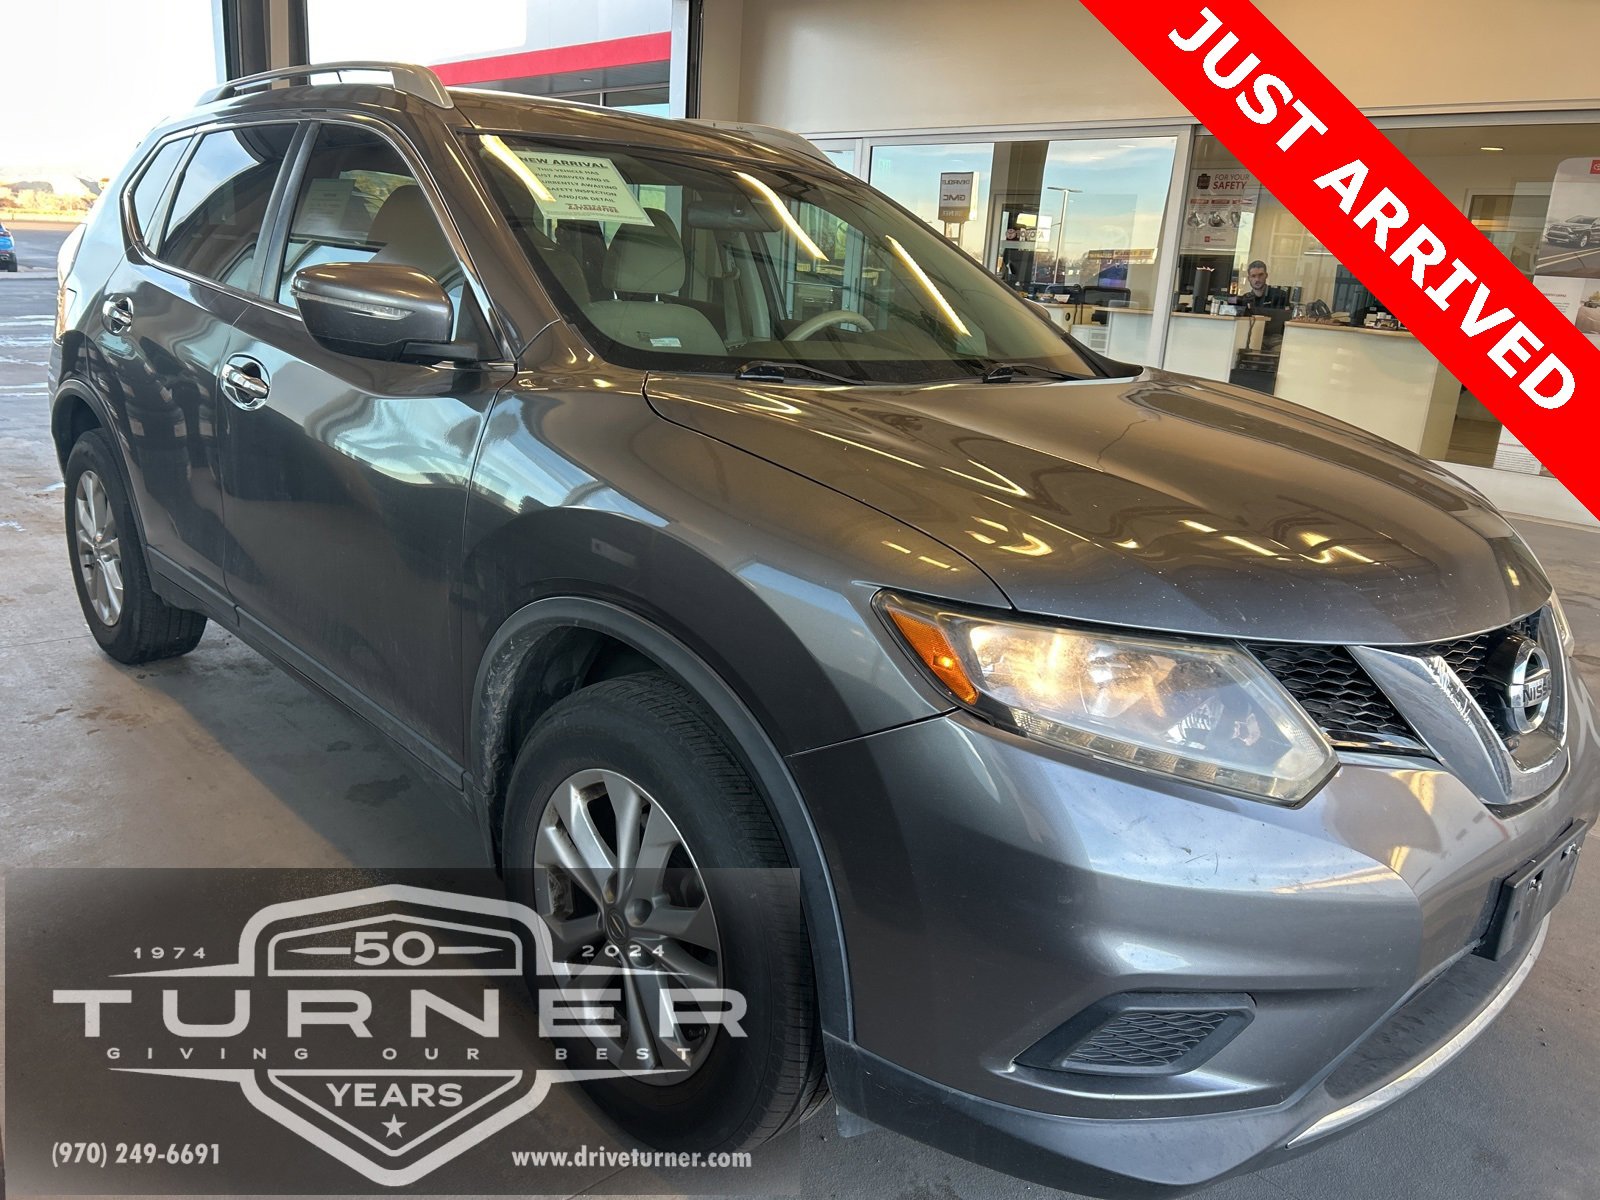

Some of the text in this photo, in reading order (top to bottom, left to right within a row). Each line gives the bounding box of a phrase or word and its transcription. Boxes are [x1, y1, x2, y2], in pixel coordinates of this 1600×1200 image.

[519, 156, 609, 169] NEW ARRIVAL
[1214, 173, 1250, 181] FOR YOUR
[581, 182, 618, 190] AWAITING
[1213, 181, 1248, 190] SAFETY
[574, 189, 617, 197] INSPECTION
